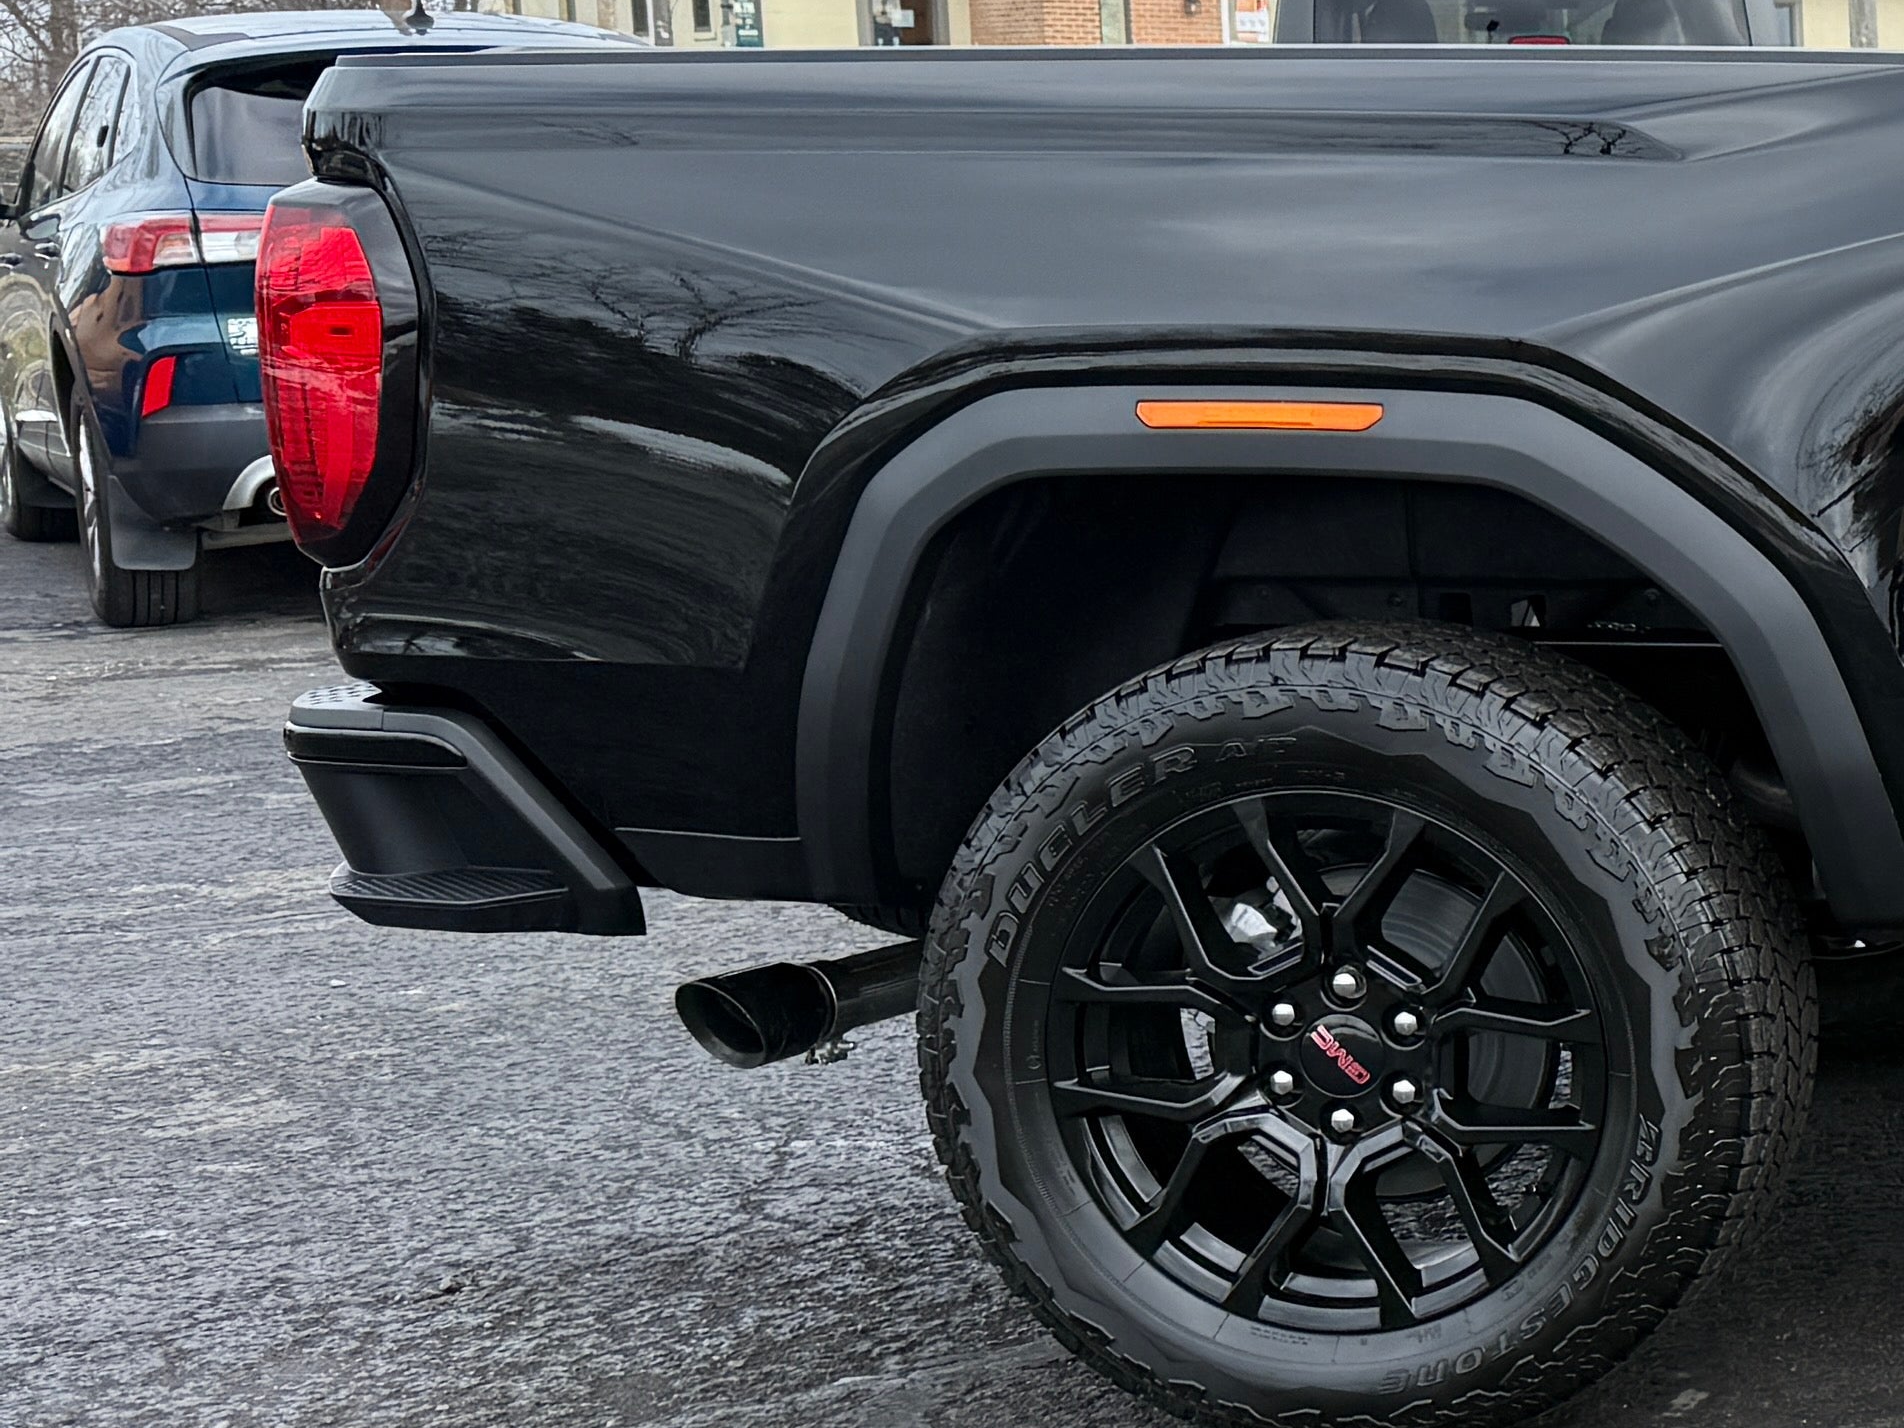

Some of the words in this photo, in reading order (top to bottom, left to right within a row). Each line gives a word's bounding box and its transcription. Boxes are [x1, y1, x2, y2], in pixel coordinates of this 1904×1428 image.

[986, 745, 1197, 968] DUELER
[1310, 1024, 1371, 1085] GMC
[1377, 1112, 1662, 1395] BRIDGESTONE
